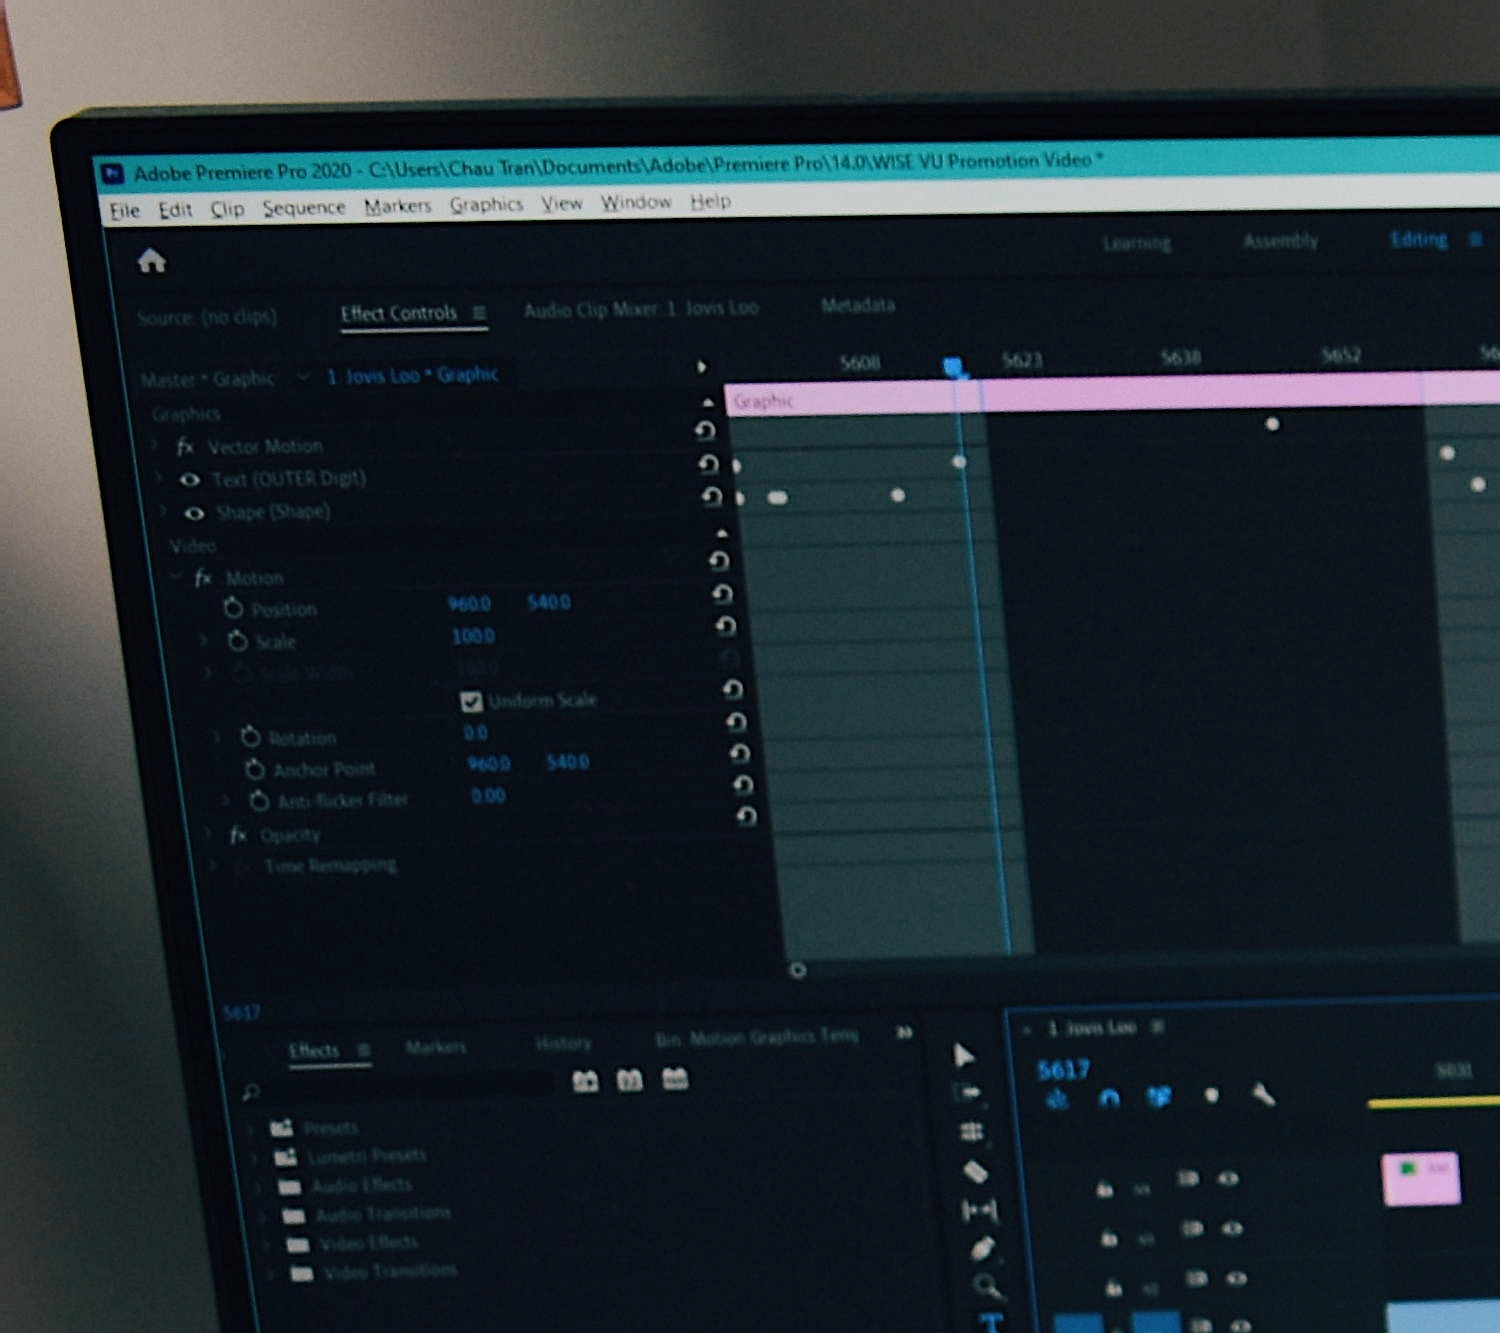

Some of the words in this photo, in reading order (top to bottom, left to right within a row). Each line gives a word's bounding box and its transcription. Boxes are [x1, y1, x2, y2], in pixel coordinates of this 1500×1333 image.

[134, 163, 192, 183] Adobe
[195, 162, 272, 182] Premiere
[276, 161, 307, 180] Pro
[310, 161, 352, 180] 2020
[918, 151, 943, 169] VU
[947, 150, 1042, 170] Promotion
[1046, 149, 1093, 168] Video
[109, 201, 141, 221] File
[158, 199, 194, 219] Edit
[210, 199, 246, 222] Clip
[262, 197, 347, 220] Sequence
[363, 196, 433, 217] Markers
[448, 194, 525, 216] Graphics
[540, 193, 584, 214] View
[600, 191, 673, 212] Window
[690, 190, 732, 213] Help
[1103, 232, 1173, 256] Learning
[1243, 230, 1319, 254] Assembly
[1390, 228, 1449, 252] Editing
[340, 303, 389, 323] Effect
[391, 303, 458, 323] Controls
[820, 296, 897, 316] Metadata
[213, 369, 276, 391] Graphic
[437, 366, 500, 387] Graphic
[212, 470, 249, 489] Text
[252, 468, 317, 491] (OUTER
[319, 467, 368, 491] Digit)
[216, 503, 266, 523] Shape
[268, 501, 332, 524] (Shape)
[168, 537, 217, 556] Video
[254, 632, 297, 651] Scale
[287, 1040, 341, 1062] Effects
[1036, 1057, 1092, 1081] 5617
